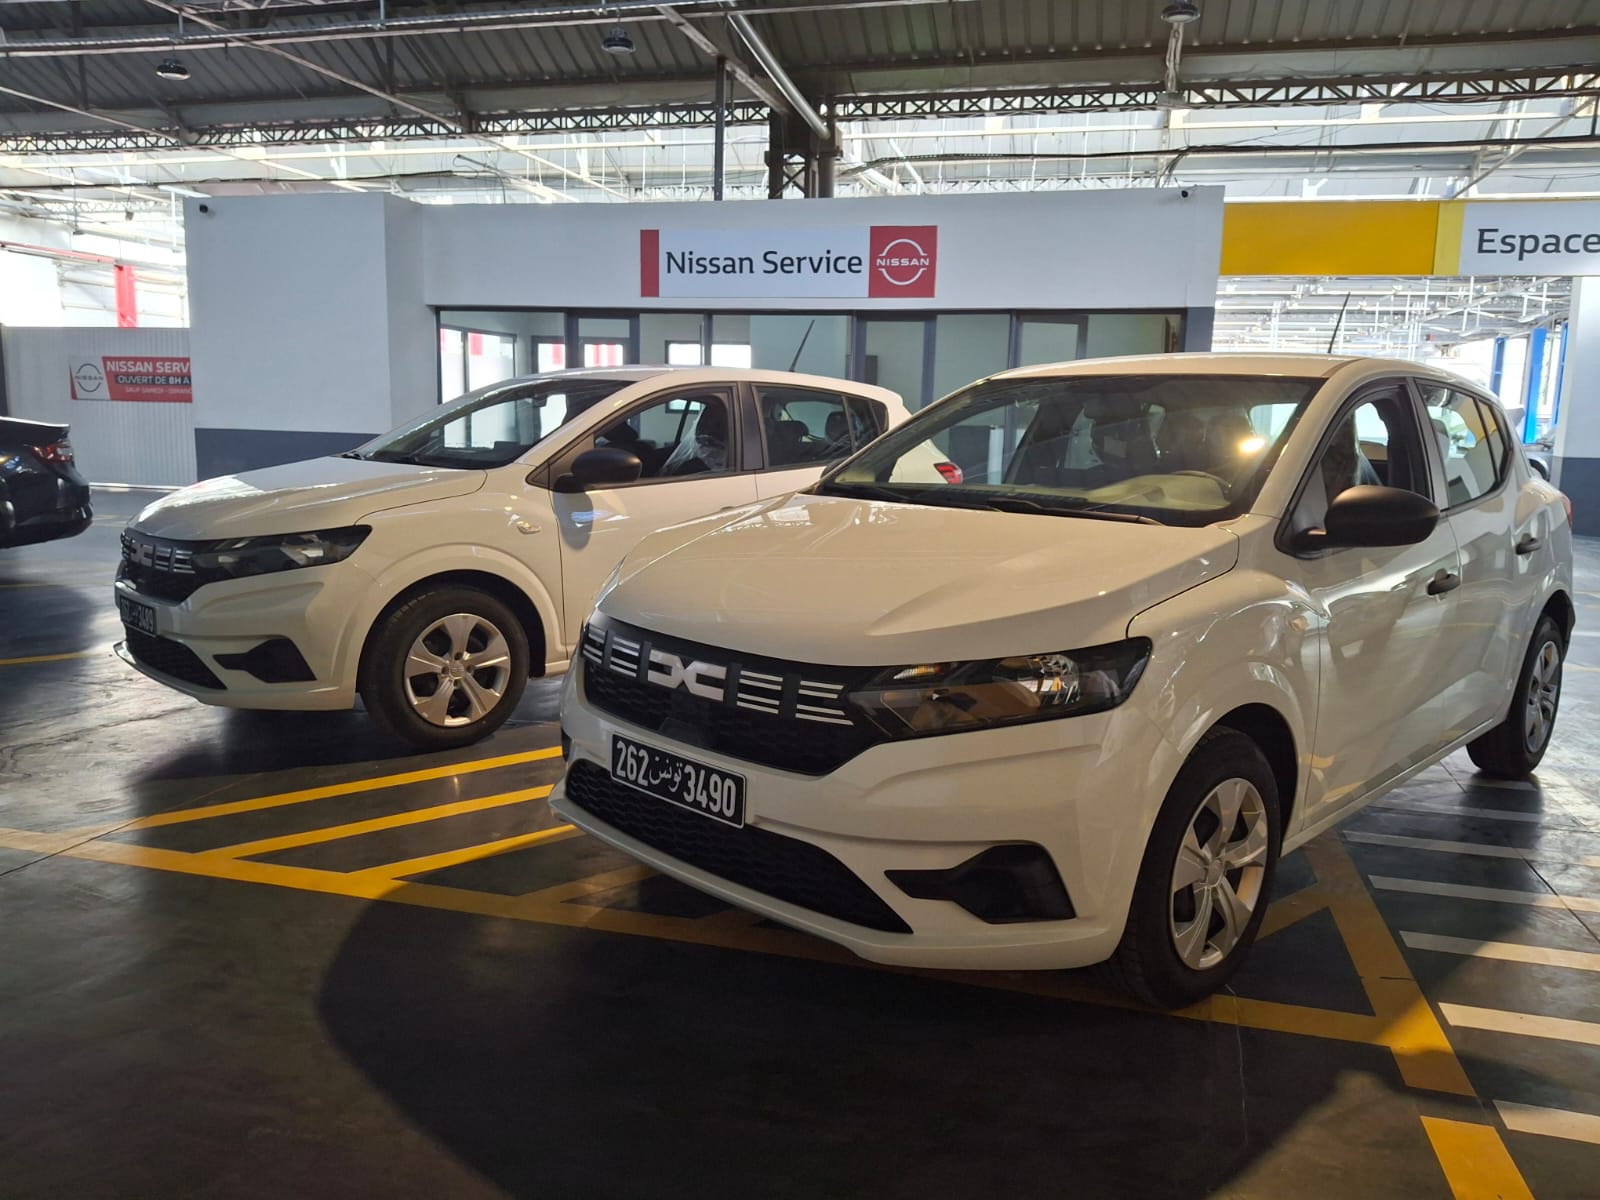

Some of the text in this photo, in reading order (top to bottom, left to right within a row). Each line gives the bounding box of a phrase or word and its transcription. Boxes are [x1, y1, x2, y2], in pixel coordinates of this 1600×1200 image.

[1477, 228, 1600, 261] Espace
[666, 250, 863, 274] Nissan Service
[875, 257, 930, 266] NISSAN
[106, 361, 191, 374] NISSAN SERV
[117, 375, 153, 384] OUVERT
[155, 376, 167, 384] DE
[169, 376, 181, 384] 8H
[615, 740, 737, 818] 262 تونس 3490
